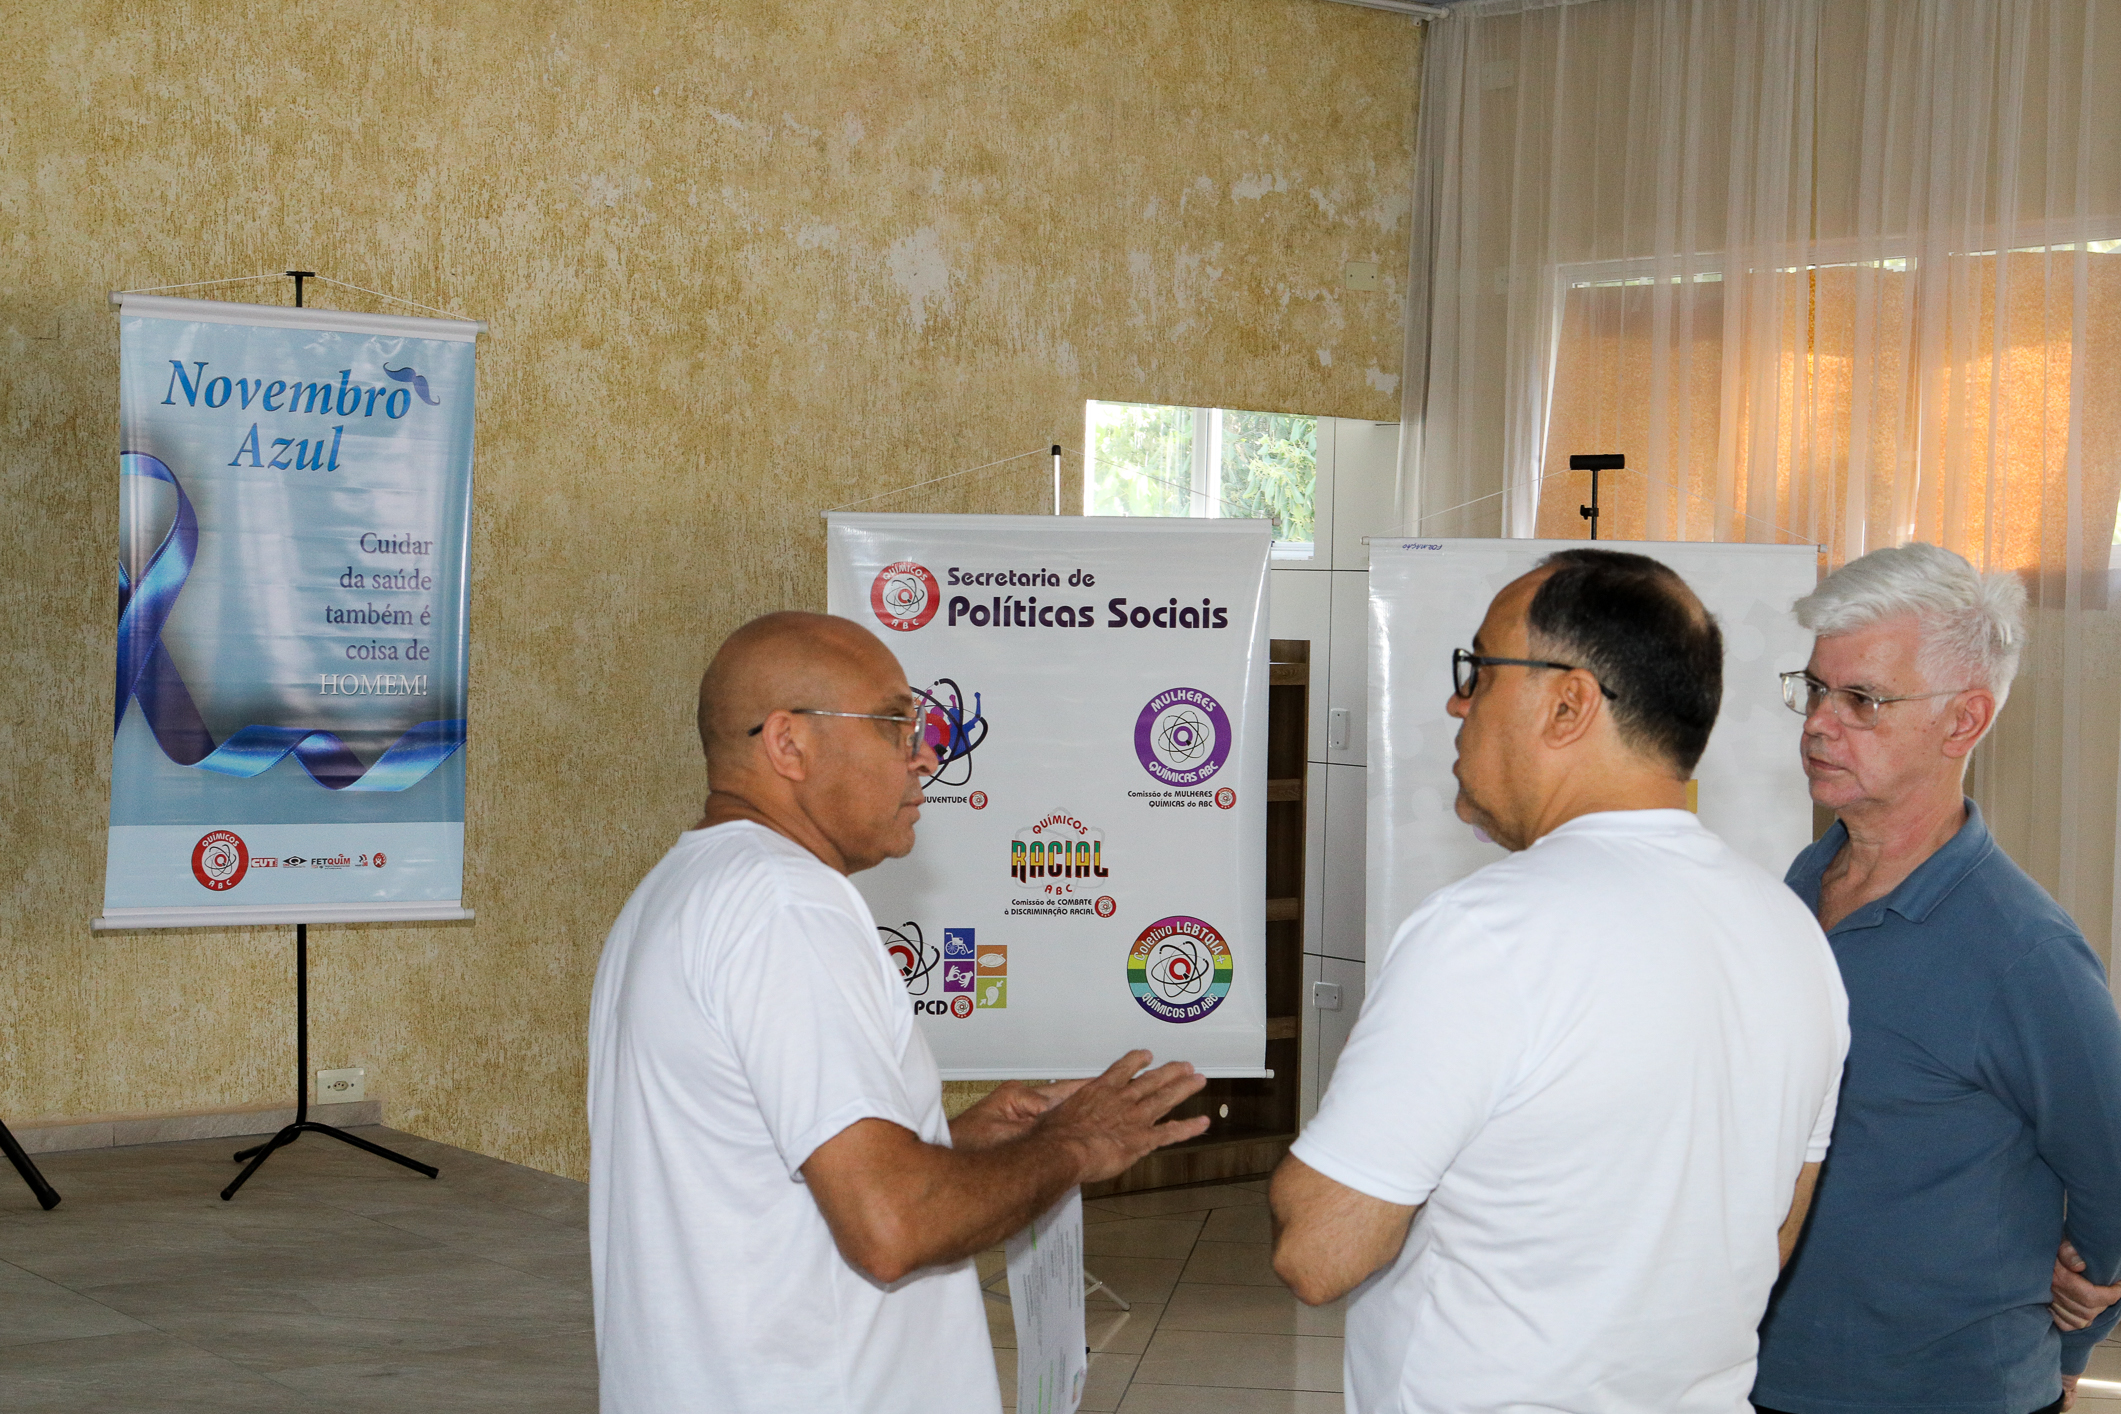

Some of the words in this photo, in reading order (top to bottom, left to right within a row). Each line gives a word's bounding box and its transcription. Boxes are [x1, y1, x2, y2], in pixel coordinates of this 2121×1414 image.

[161, 359, 412, 419] Novembro
[228, 422, 344, 472] Azul
[360, 532, 433, 555] Cuidar
[339, 566, 365, 589] da
[372, 568, 432, 590] saúde
[947, 567, 1061, 587] Secretaria
[1068, 568, 1096, 587] de
[325, 602, 413, 626] também
[420, 604, 431, 626] é
[948, 596, 1095, 628] Políticas
[1108, 598, 1229, 629] Sociais
[346, 640, 399, 660] coisa
[405, 638, 430, 660] de
[319, 673, 428, 696] HOMEM!
[1150, 689, 1217, 713] MULHERES
[1148, 761, 1198, 783] QUÍMICAS
[1198, 760, 1219, 779] ABC
[1127, 790, 1161, 798] Comissão
[1163, 790, 1173, 798] de
[1174, 790, 1213, 798] MULHERES
[1148, 799, 1185, 808] QUÍMICAS
[1187, 800, 1197, 808] do
[1198, 800, 1213, 808] ABC
[1032, 814, 1088, 835] QUÍMICOS
[251, 858, 275, 867] CUT
[1011, 840, 1109, 884] RACIAL
[1011, 898, 1045, 906] Comissão
[1046, 898, 1056, 906] de
[1057, 898, 1093, 906] COMBATE
[1011, 906, 1068, 917] DISCRIMINAÇÃO
[1069, 908, 1095, 916] RACIAL
[1133, 925, 1173, 961] Coletivo
[1176, 921, 1226, 964] LGBTQIA+
[914, 1000, 949, 1015] PCD
[1141, 992, 1186, 1018] QUÍMICOS
[1187, 1005, 1201, 1017] DO
[1201, 993, 1219, 1011] ABC
